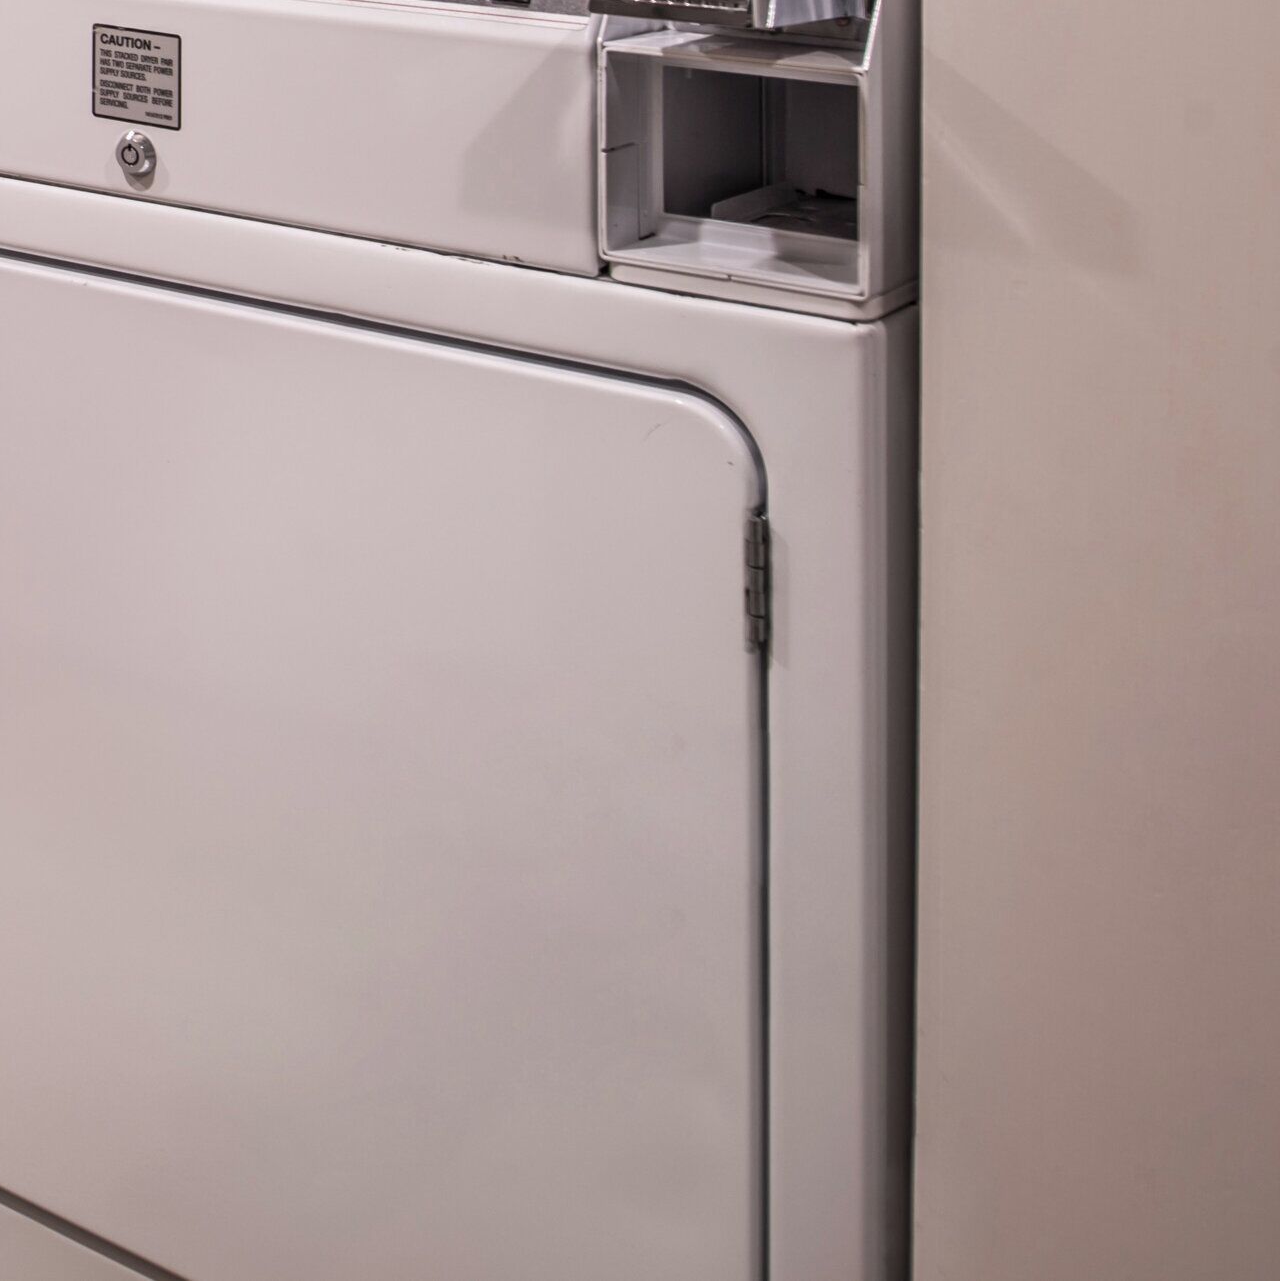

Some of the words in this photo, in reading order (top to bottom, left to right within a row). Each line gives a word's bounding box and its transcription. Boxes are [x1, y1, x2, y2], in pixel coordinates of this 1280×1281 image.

[100, 33, 152, 50] CAUTION
[100, 48, 113, 58] THIS
[114, 51, 139, 61] STACKED
[141, 54, 159, 64] DRYER
[100, 58, 111, 67] HAS
[112, 59, 125, 68] TWO
[126, 61, 152, 73] SEPARATE
[153, 66, 174, 76] POWER
[100, 67, 120, 77] SUPPLY
[120, 70, 147, 81] SOURCES.
[100, 79, 134, 91] DISCONNECT
[136, 85, 151, 94] BOTH
[153, 88, 173, 98] POWER
[100, 88, 120, 98] SUPPLY
[123, 92, 149, 103] SOURCES
[151, 96, 173, 108] BEFORE
